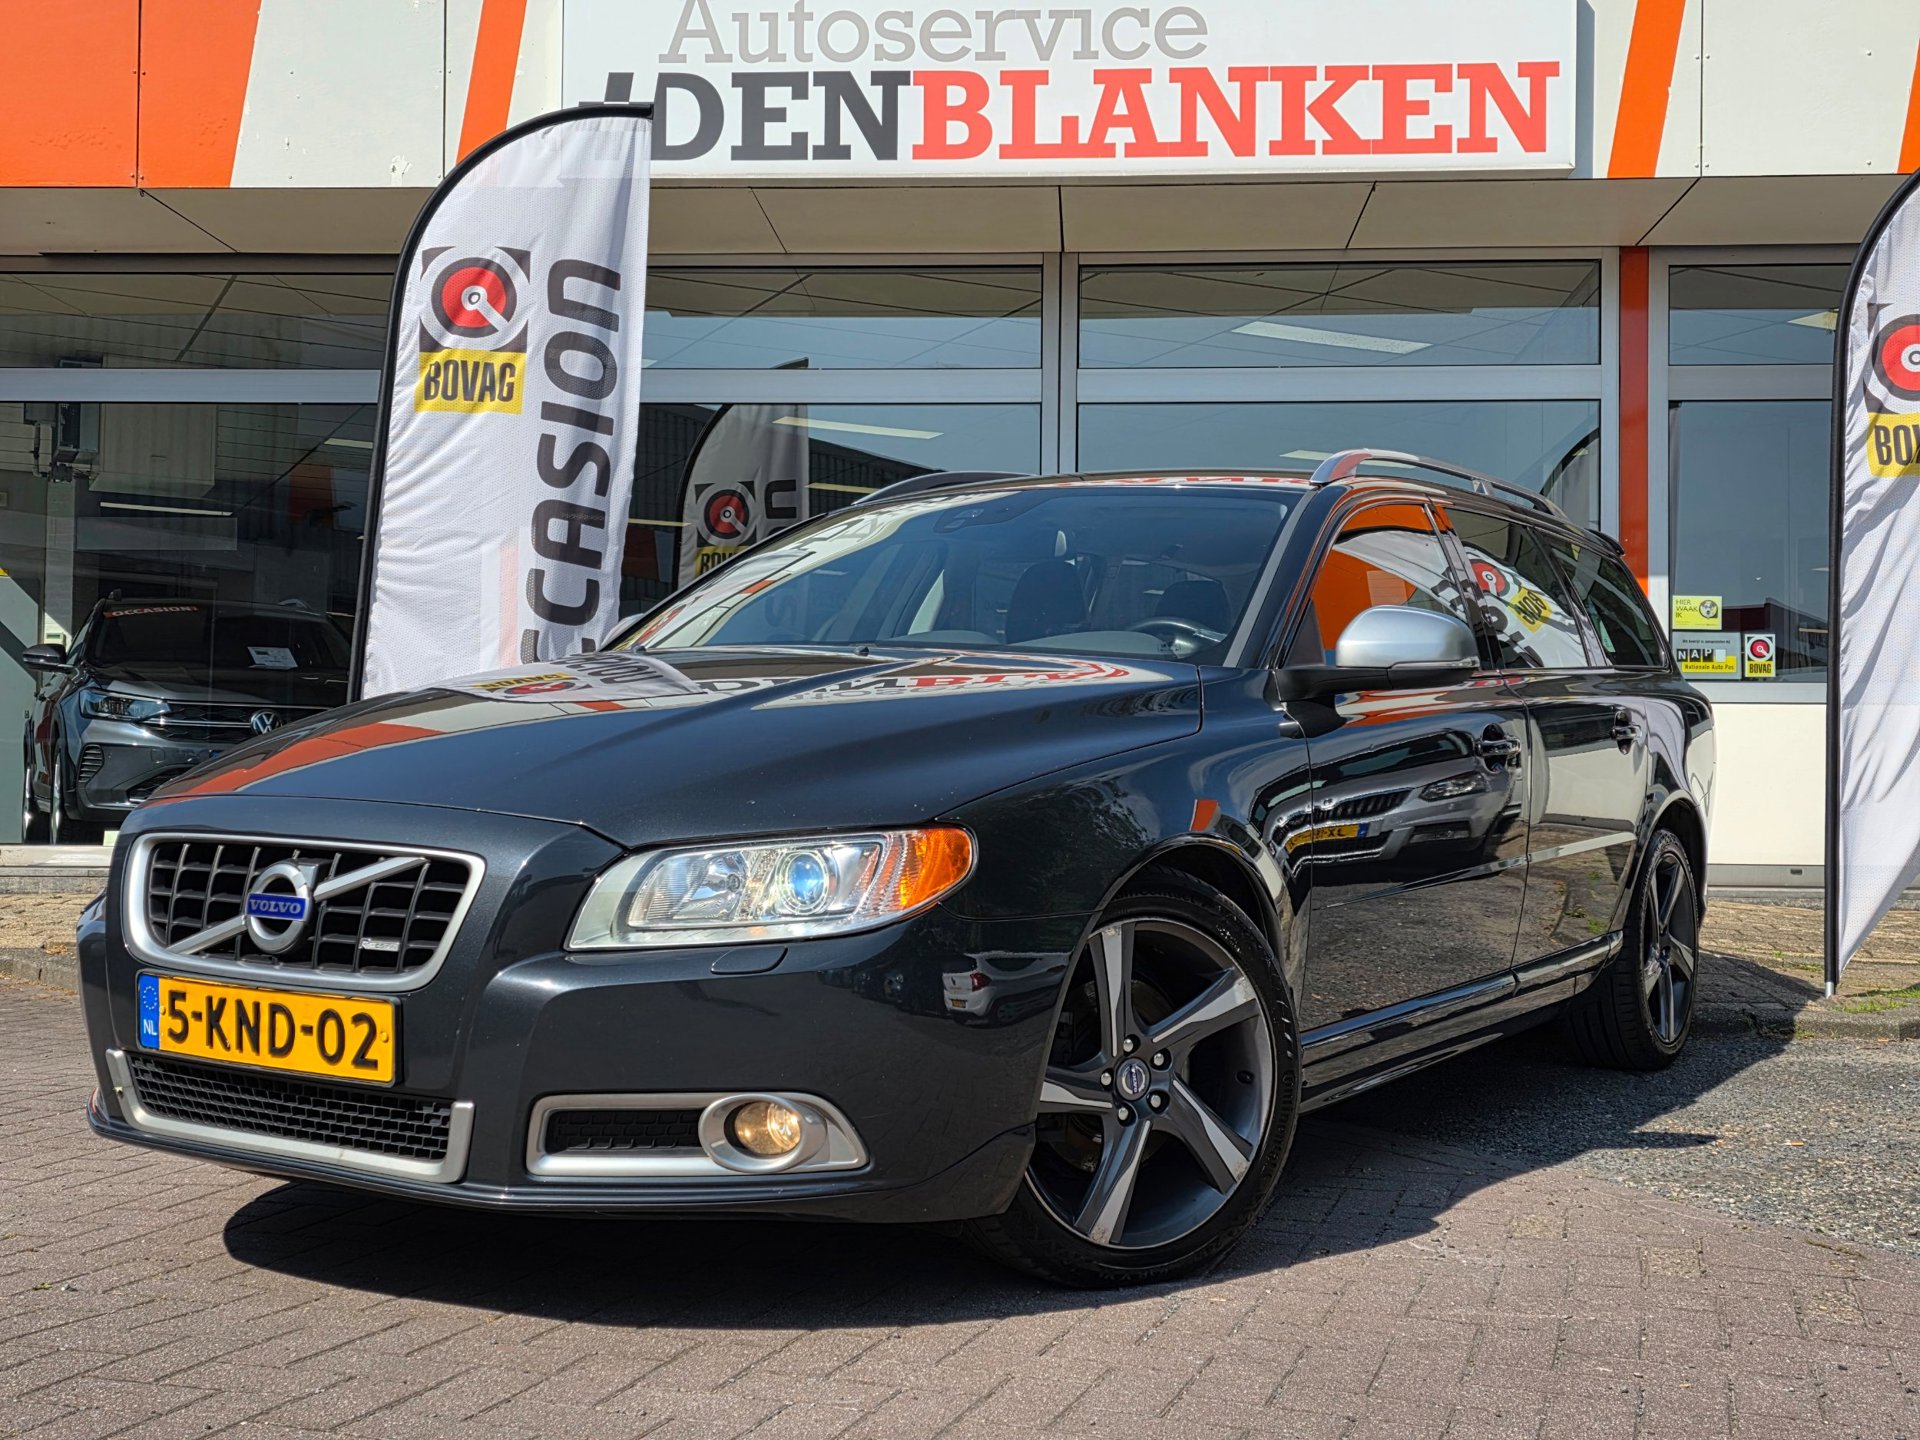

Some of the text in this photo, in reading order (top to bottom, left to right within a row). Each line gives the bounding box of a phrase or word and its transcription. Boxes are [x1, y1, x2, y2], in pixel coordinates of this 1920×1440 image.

[658, 0, 1208, 64] Autoservice
[423, 359, 516, 402] BOVAG
[1678, 648, 1712, 660] NAP
[1749, 663, 1772, 674] BOVAG
[249, 899, 302, 915] VOLVO
[143, 1018, 158, 1036] NL
[167, 989, 378, 1071] 5-KND-02
